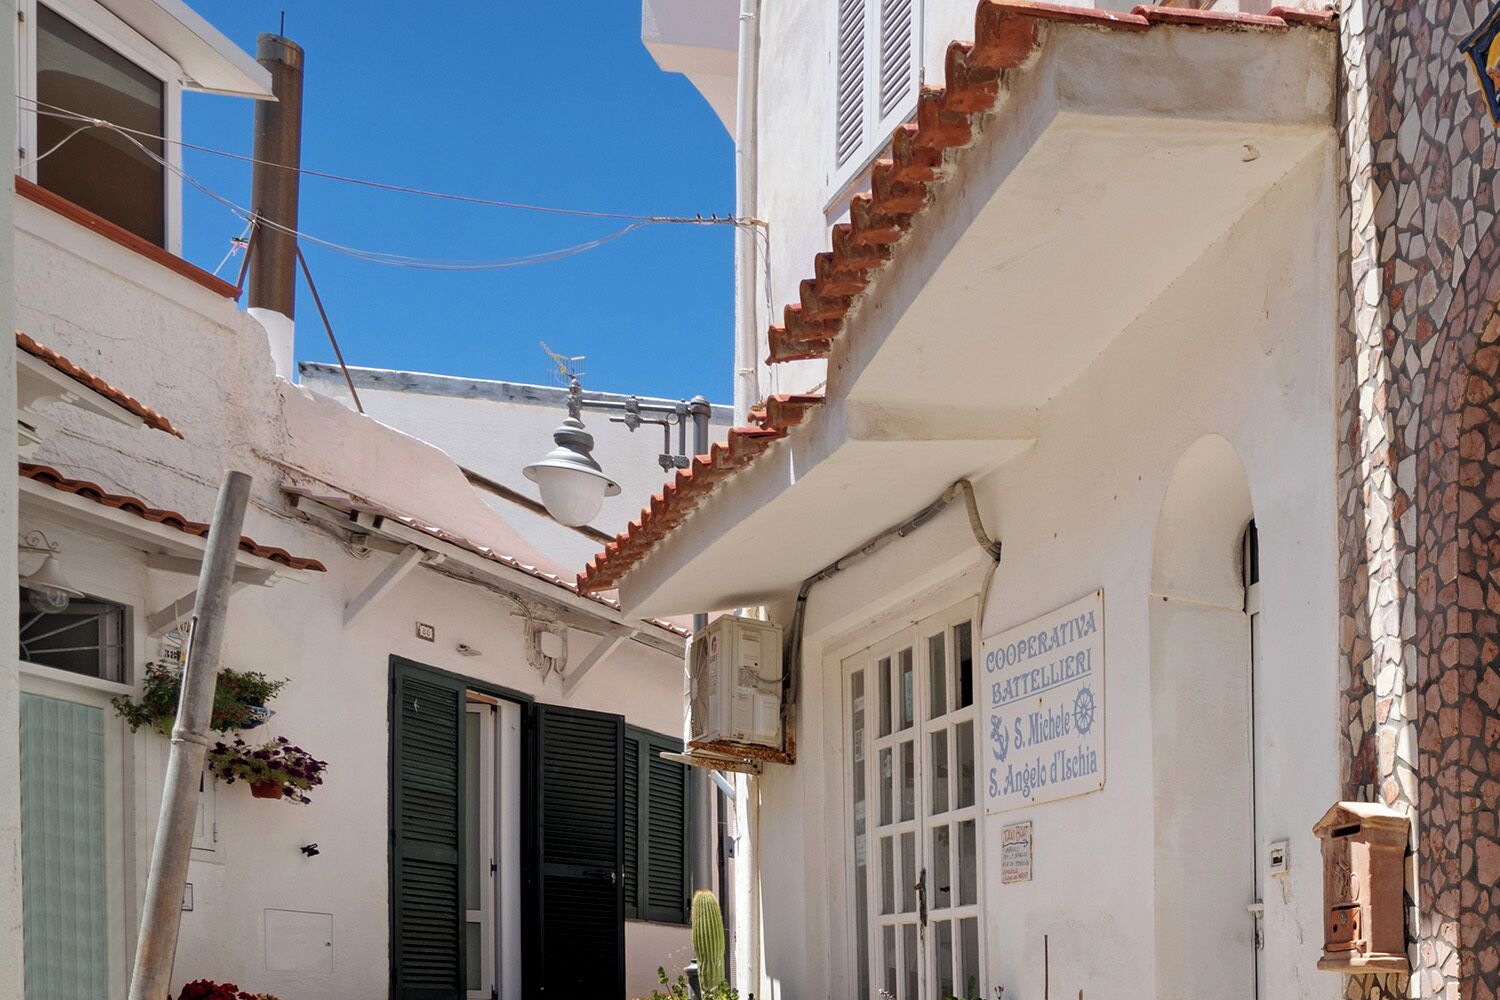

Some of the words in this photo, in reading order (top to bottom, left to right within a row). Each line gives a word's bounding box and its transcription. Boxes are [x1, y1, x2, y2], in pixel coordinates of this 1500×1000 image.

[985, 610, 1097, 674] COOPERATIVA
[991, 648, 1092, 705] BATTELLIERI
[1014, 718, 1026, 750] S.
[1028, 704, 1071, 746] Michele
[989, 767, 1001, 798] S.
[1003, 763, 1047, 799] Angelo
[1050, 749, 1098, 791] d'Ischia
